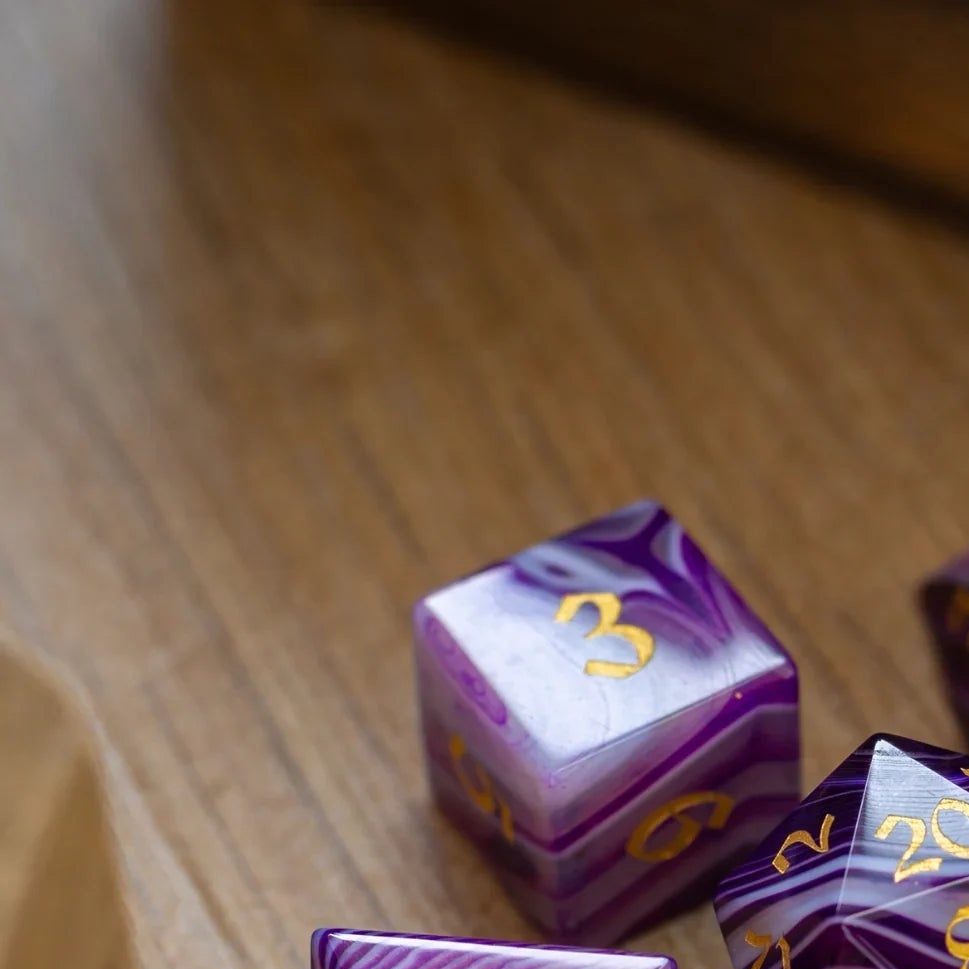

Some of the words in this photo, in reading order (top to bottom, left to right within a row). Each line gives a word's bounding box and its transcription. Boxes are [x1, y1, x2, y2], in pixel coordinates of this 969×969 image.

[554, 592, 655, 679] 3
[625, 791, 734, 862] 6
[771, 813, 835, 874] 2
